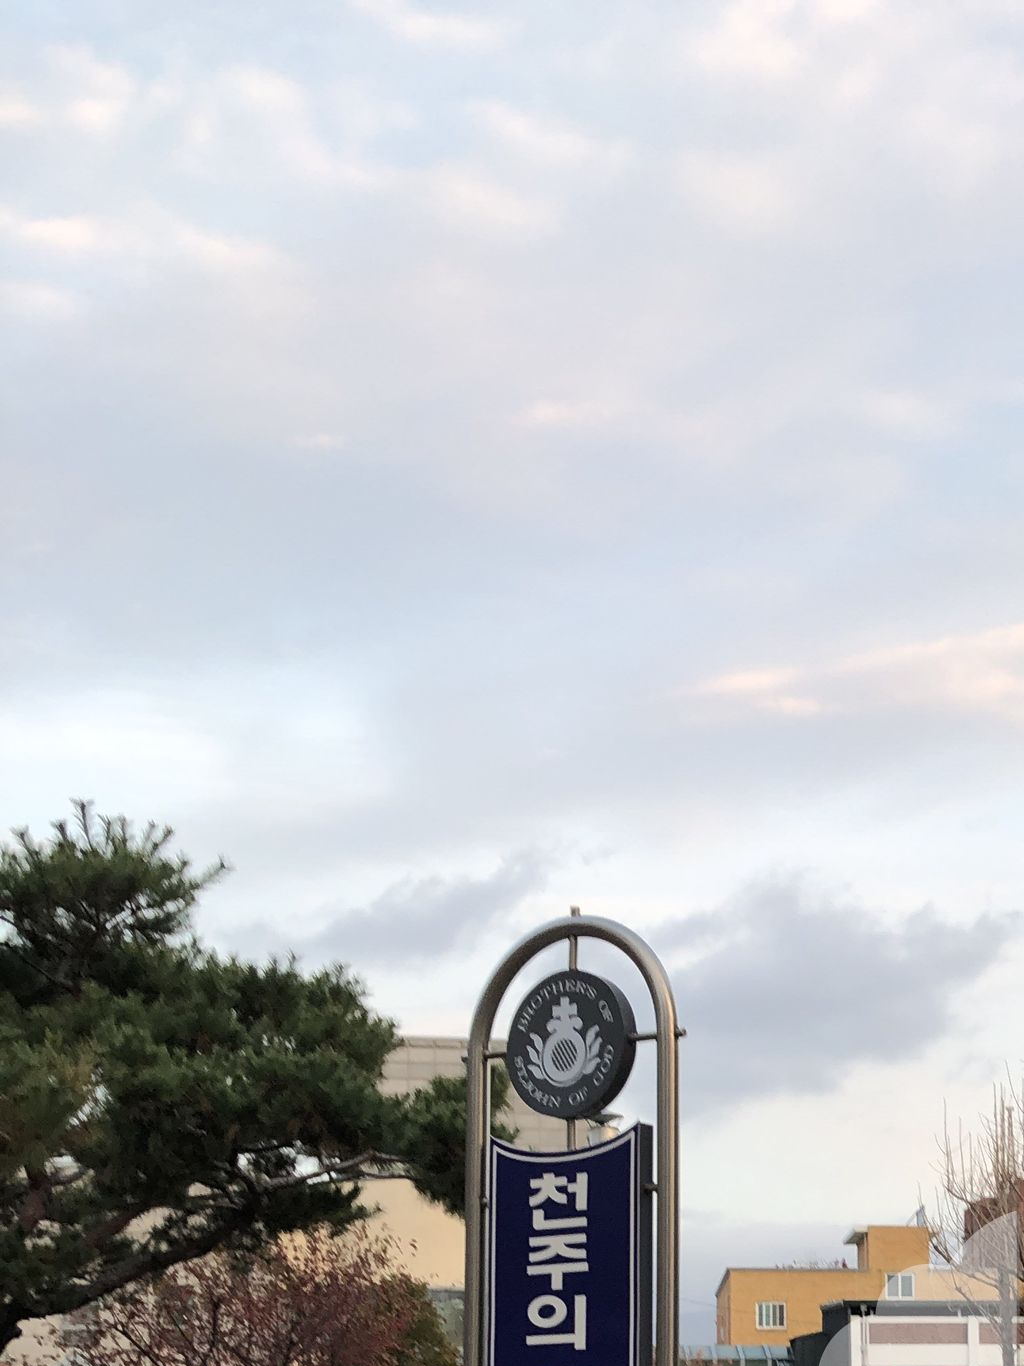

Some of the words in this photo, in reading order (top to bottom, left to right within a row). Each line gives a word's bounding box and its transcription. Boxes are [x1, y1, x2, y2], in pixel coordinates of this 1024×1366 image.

[568, 1086, 589, 1106] OF
[593, 1044, 614, 1087] GOD
[526, 1171, 590, 1351] 천주의
